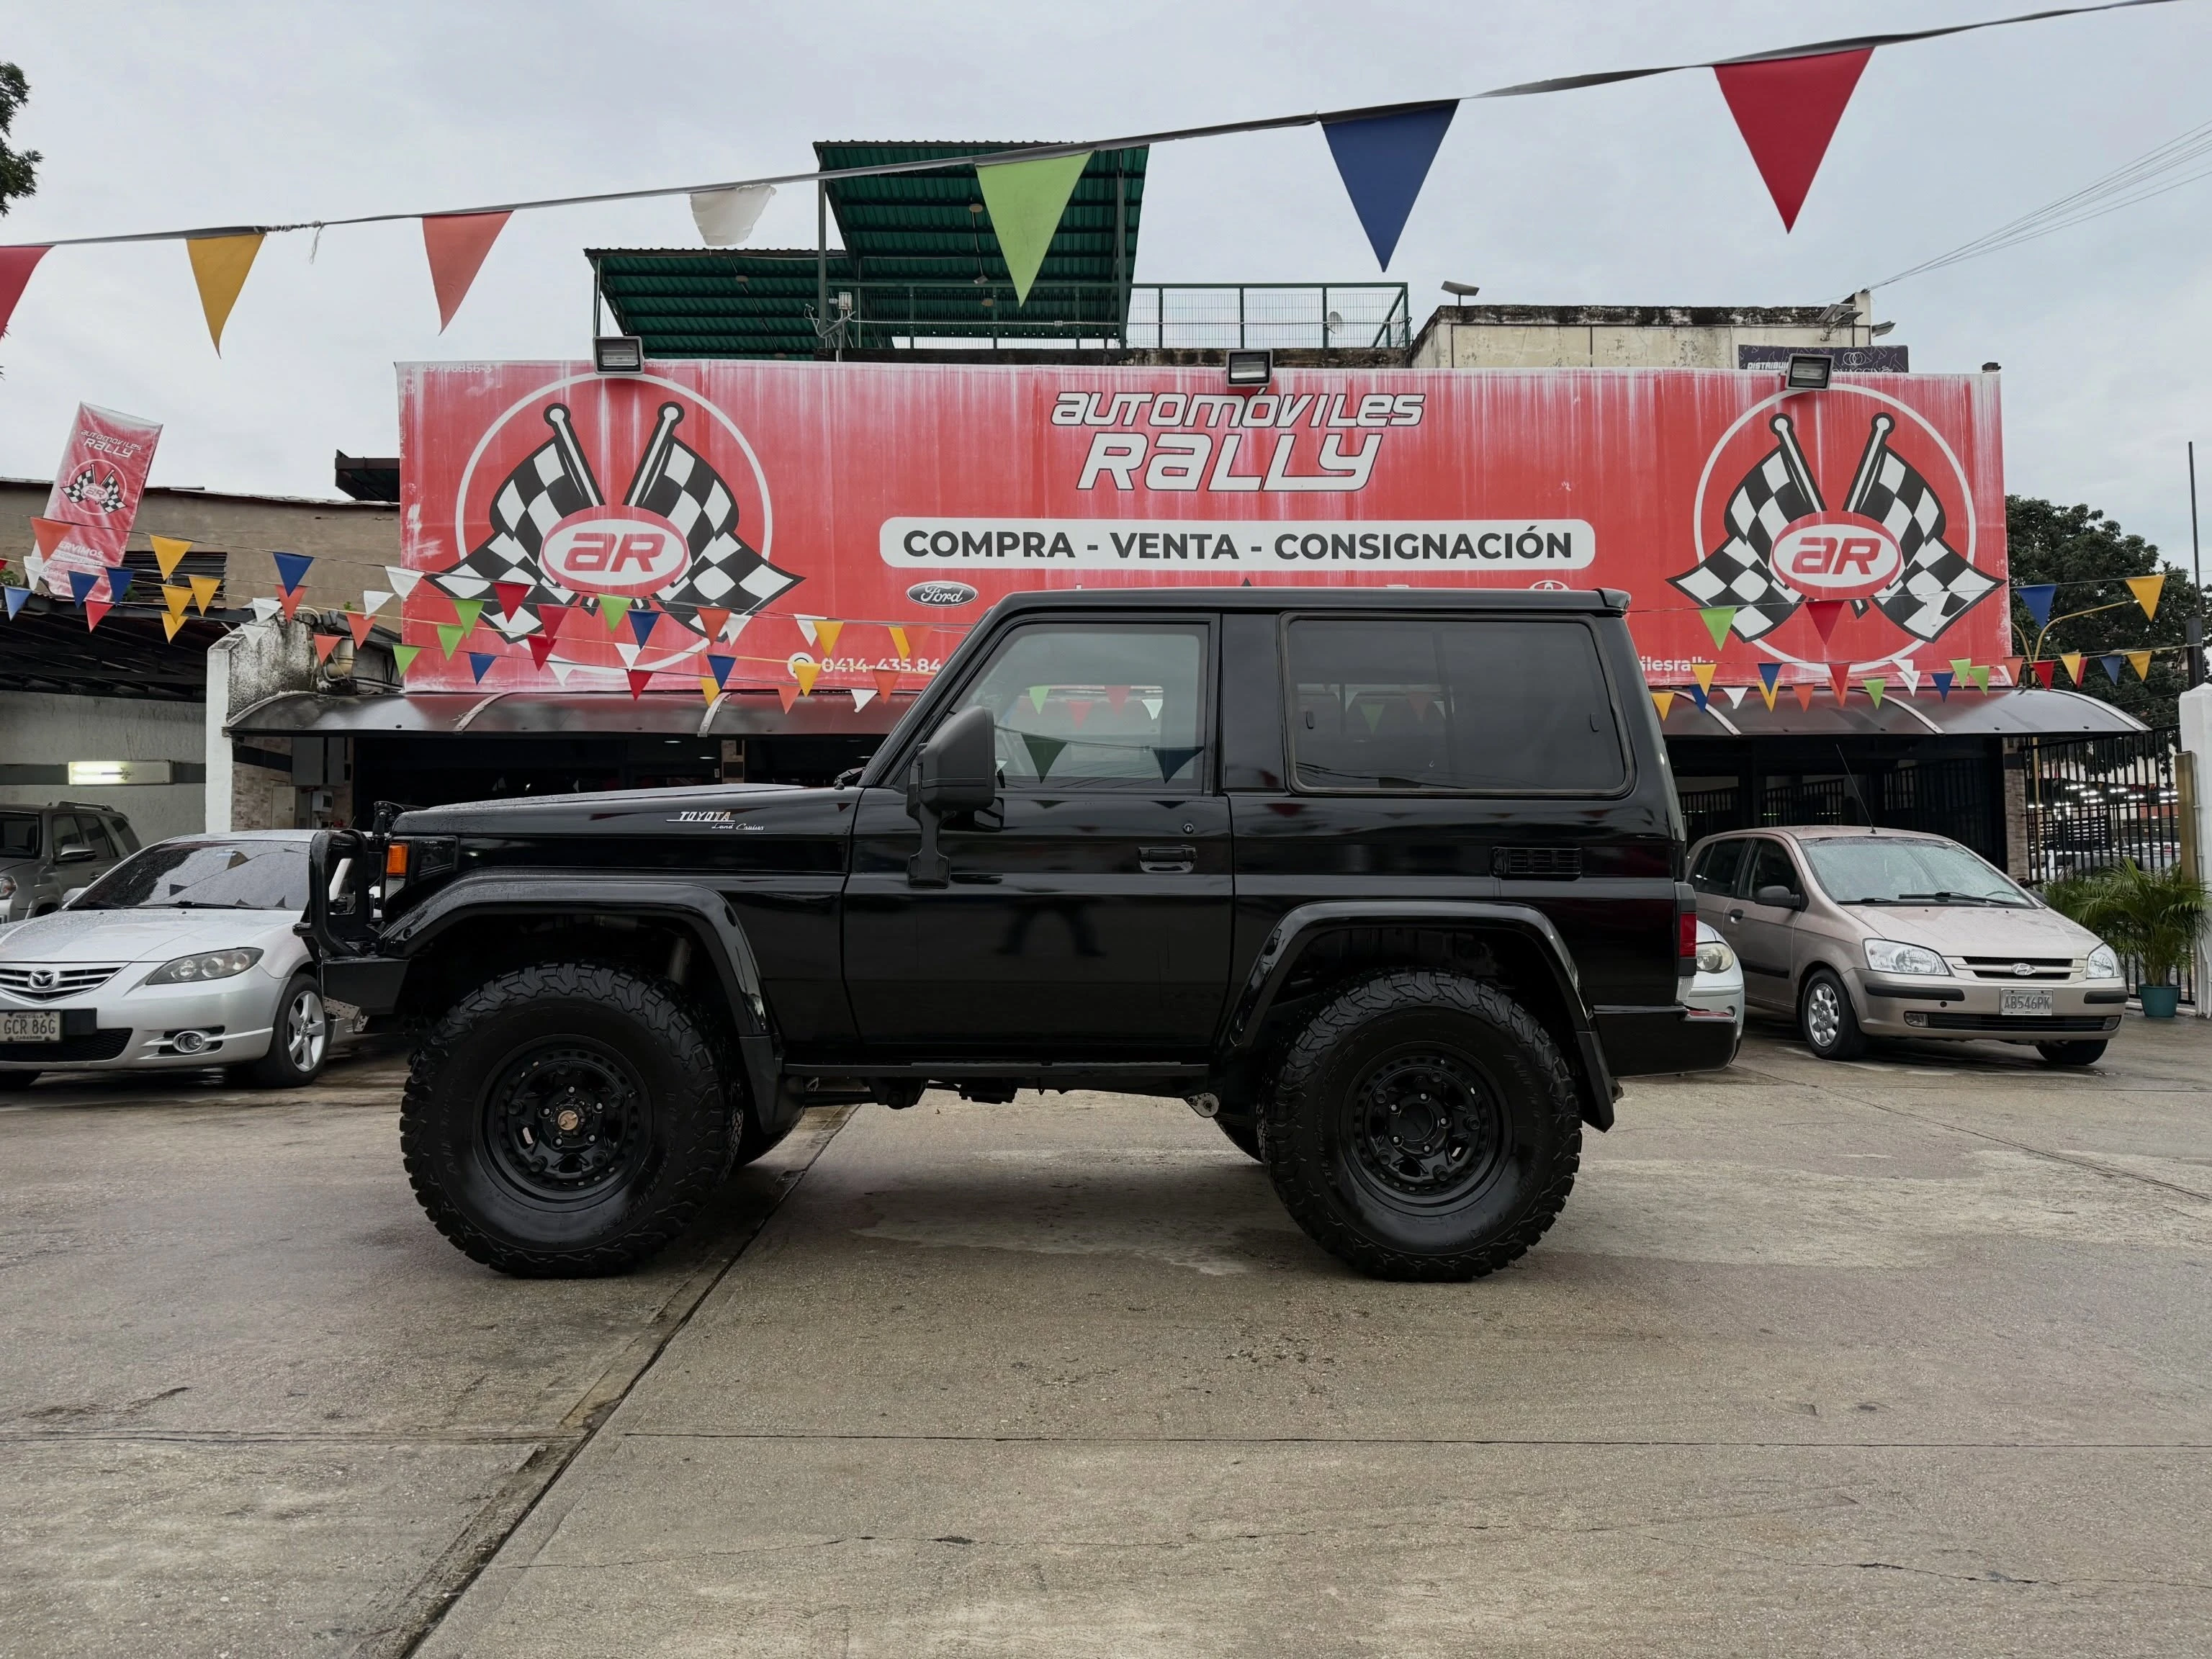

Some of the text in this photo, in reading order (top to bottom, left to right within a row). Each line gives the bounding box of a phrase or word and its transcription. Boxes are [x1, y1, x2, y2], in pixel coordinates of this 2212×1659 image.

[903, 530, 1076, 558] COMPRA
[1109, 532, 1239, 559] VENTA
[1274, 526, 1572, 560] CONSIGNACIÓN
[920, 584, 964, 603] Ford
[821, 657, 942, 673] 0414-435.84
[680, 811, 732, 821] TOYOTA
[2004, 996, 2050, 1010] AB546PK
[4, 1019, 56, 1035] GCR 86G
